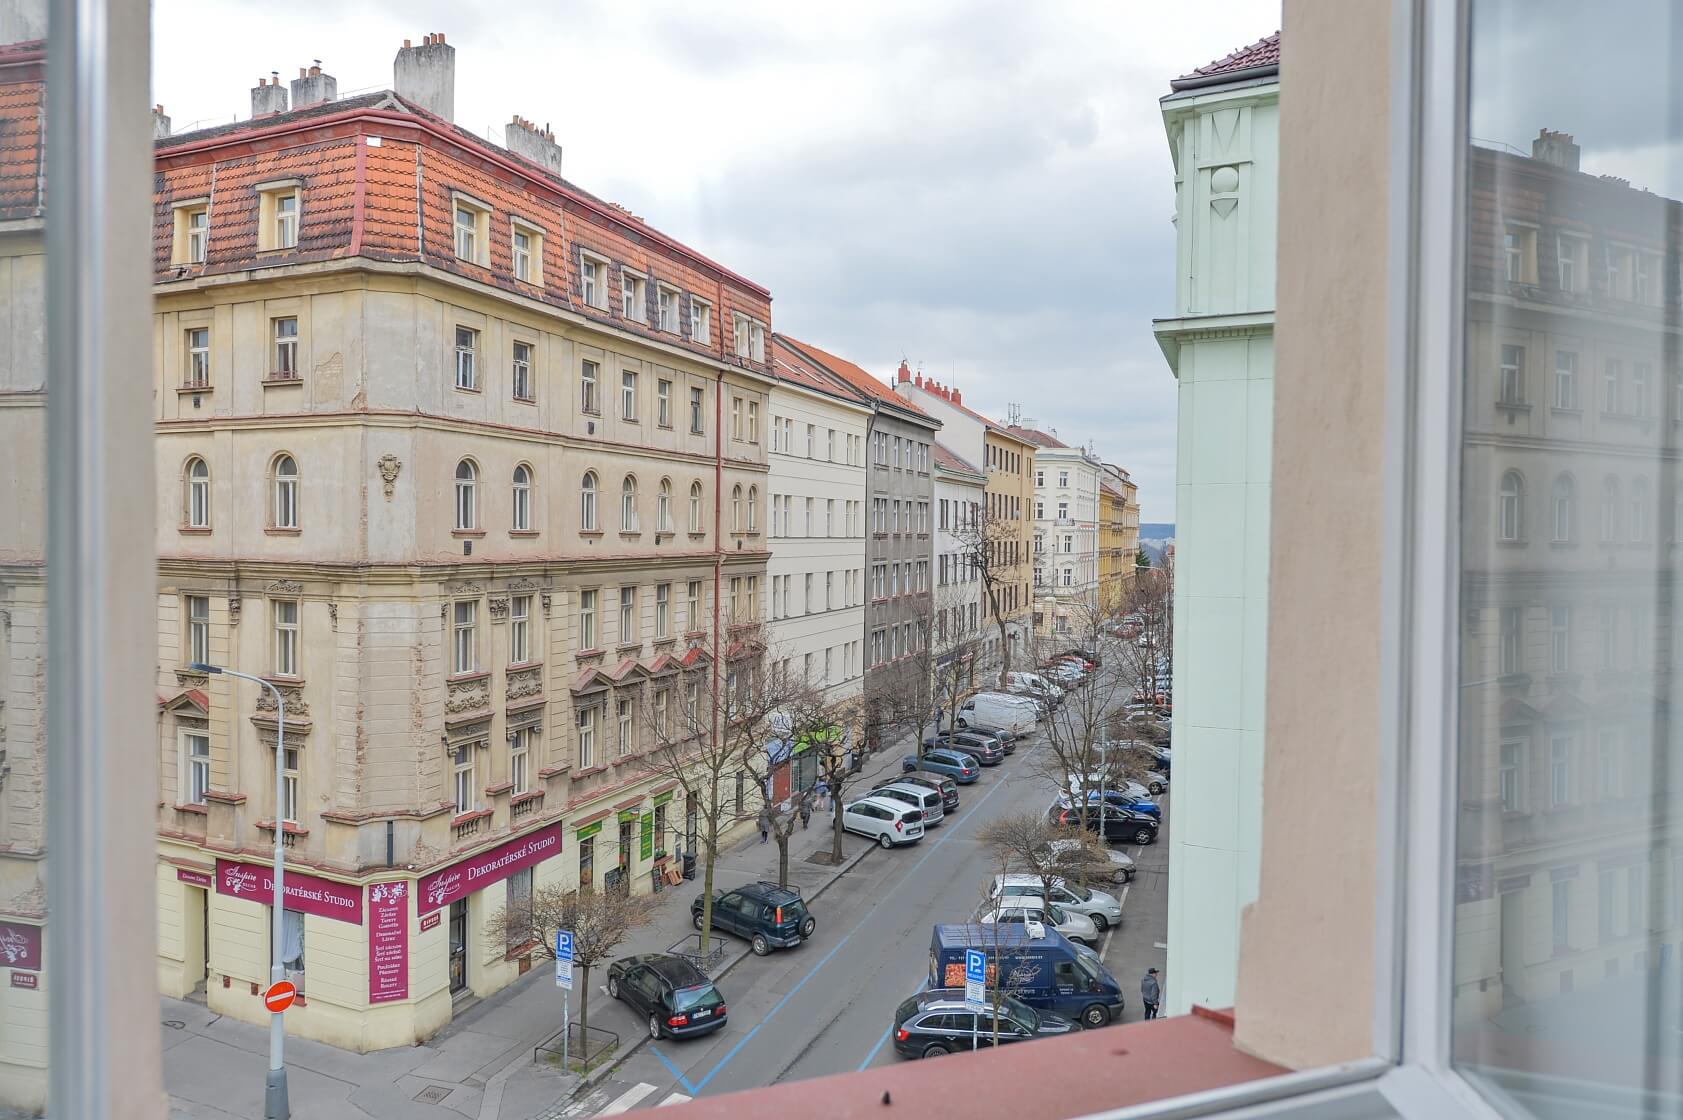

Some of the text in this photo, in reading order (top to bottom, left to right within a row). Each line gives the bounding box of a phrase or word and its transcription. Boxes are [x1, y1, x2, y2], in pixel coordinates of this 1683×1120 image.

[528, 836, 555, 854] STUDIO
[264, 879, 354, 908] DEORATÉRSKÉ STUDIO
[560, 934, 570, 950] P
[970, 954, 982, 972] P
